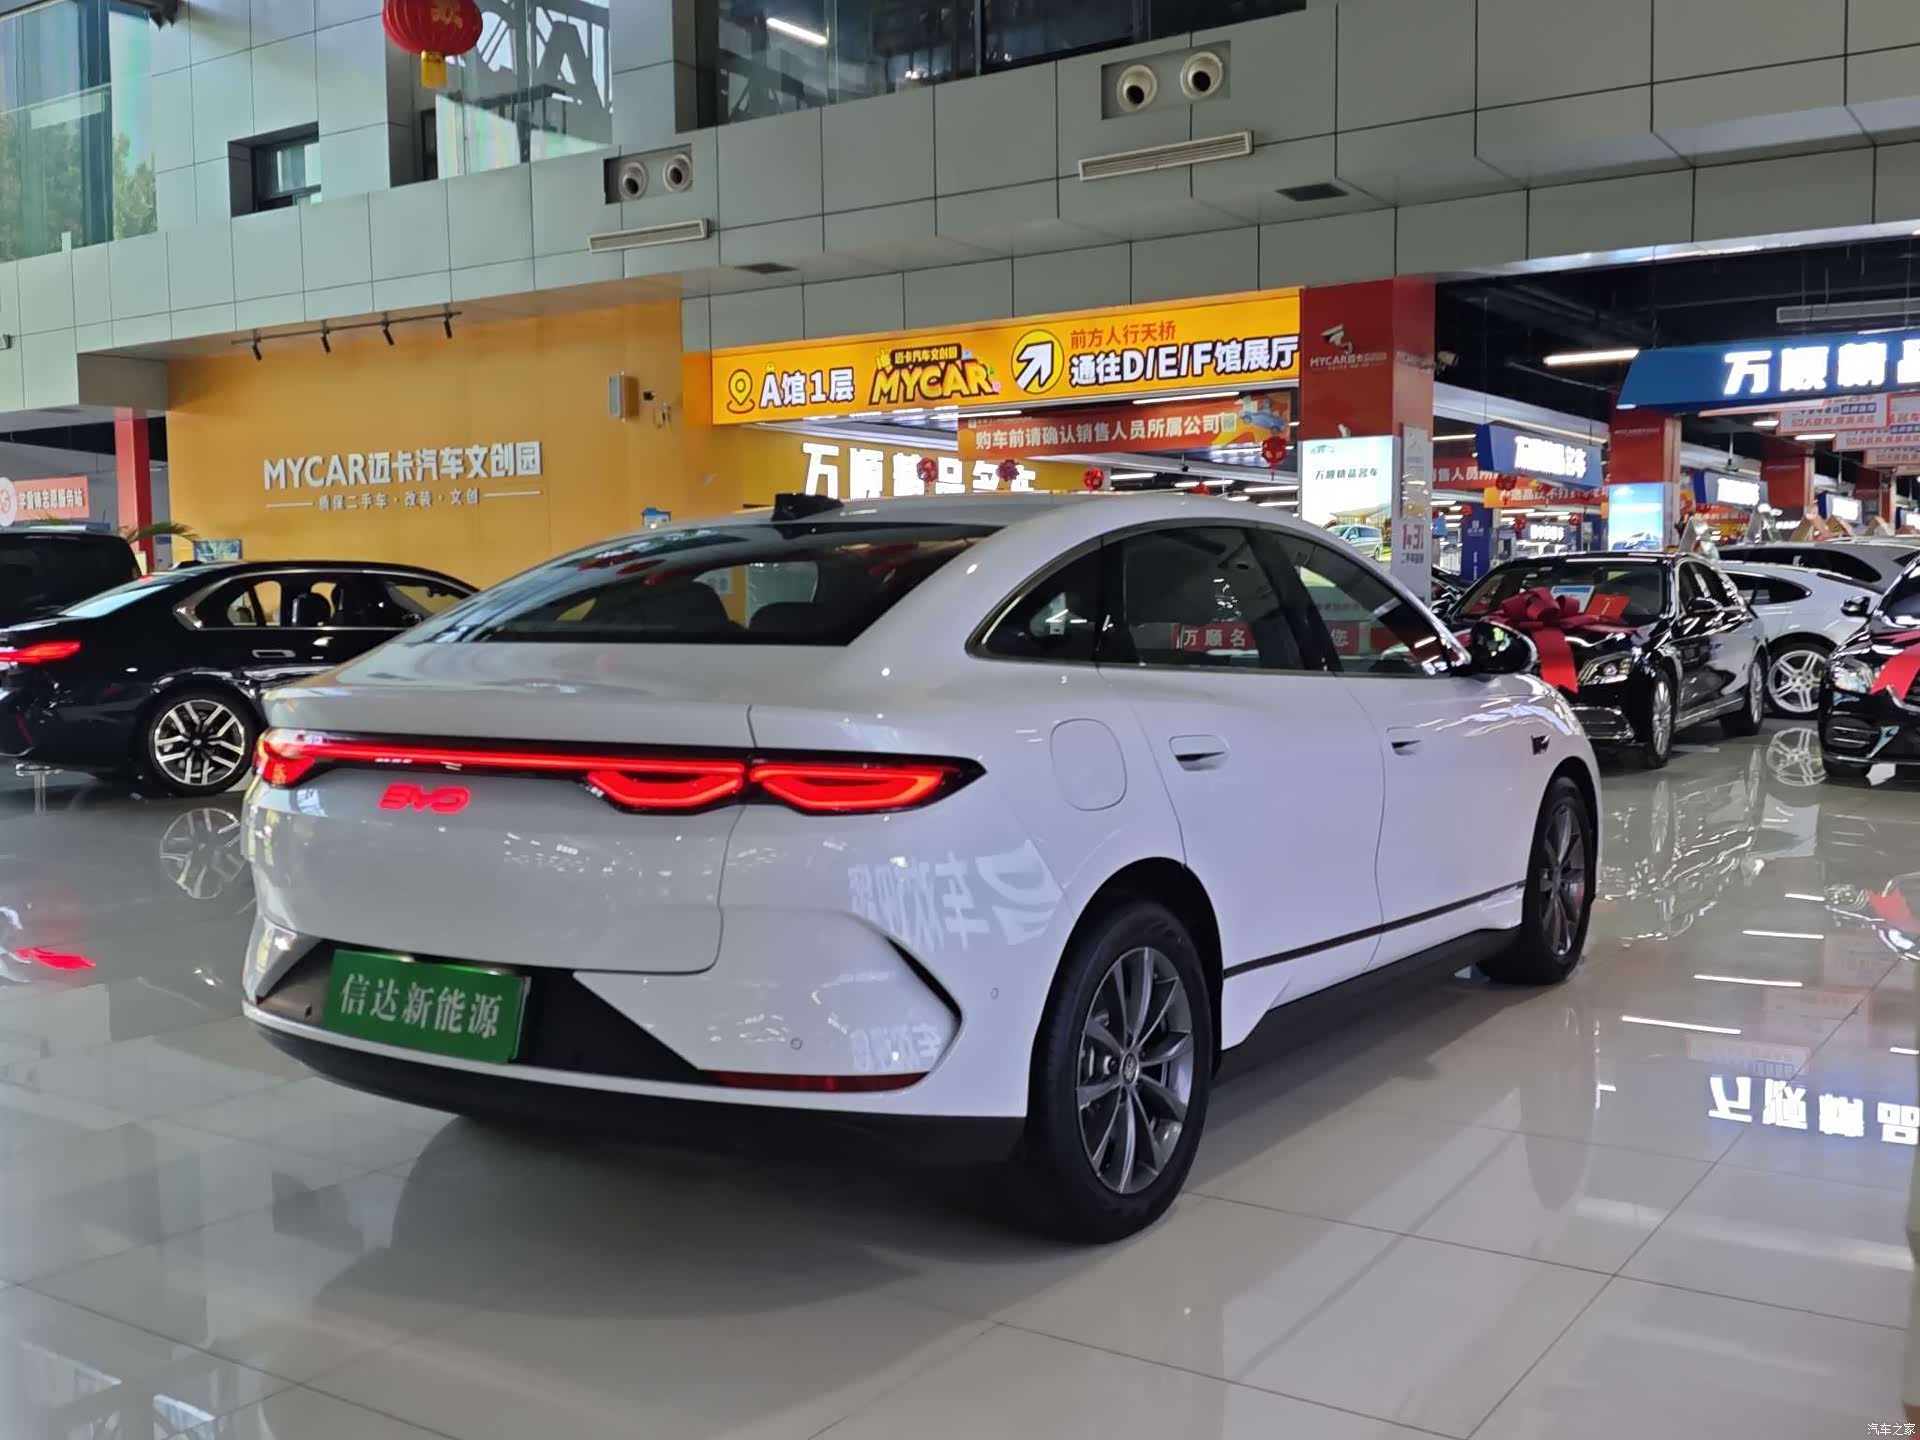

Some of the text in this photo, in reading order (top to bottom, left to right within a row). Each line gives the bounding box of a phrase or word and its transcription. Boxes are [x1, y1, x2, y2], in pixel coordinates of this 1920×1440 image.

[1070, 320, 1177, 349] 前方人行天桥
[1071, 335, 1299, 386] 通往D/E/F馆展厅
[759, 368, 855, 409] A馆1层
[869, 361, 1000, 406] MYCAR
[263, 441, 542, 490] MYCAR迈卡汽车文创园
[379, 782, 470, 814] BYD
[340, 972, 503, 1039] 信达新能源
